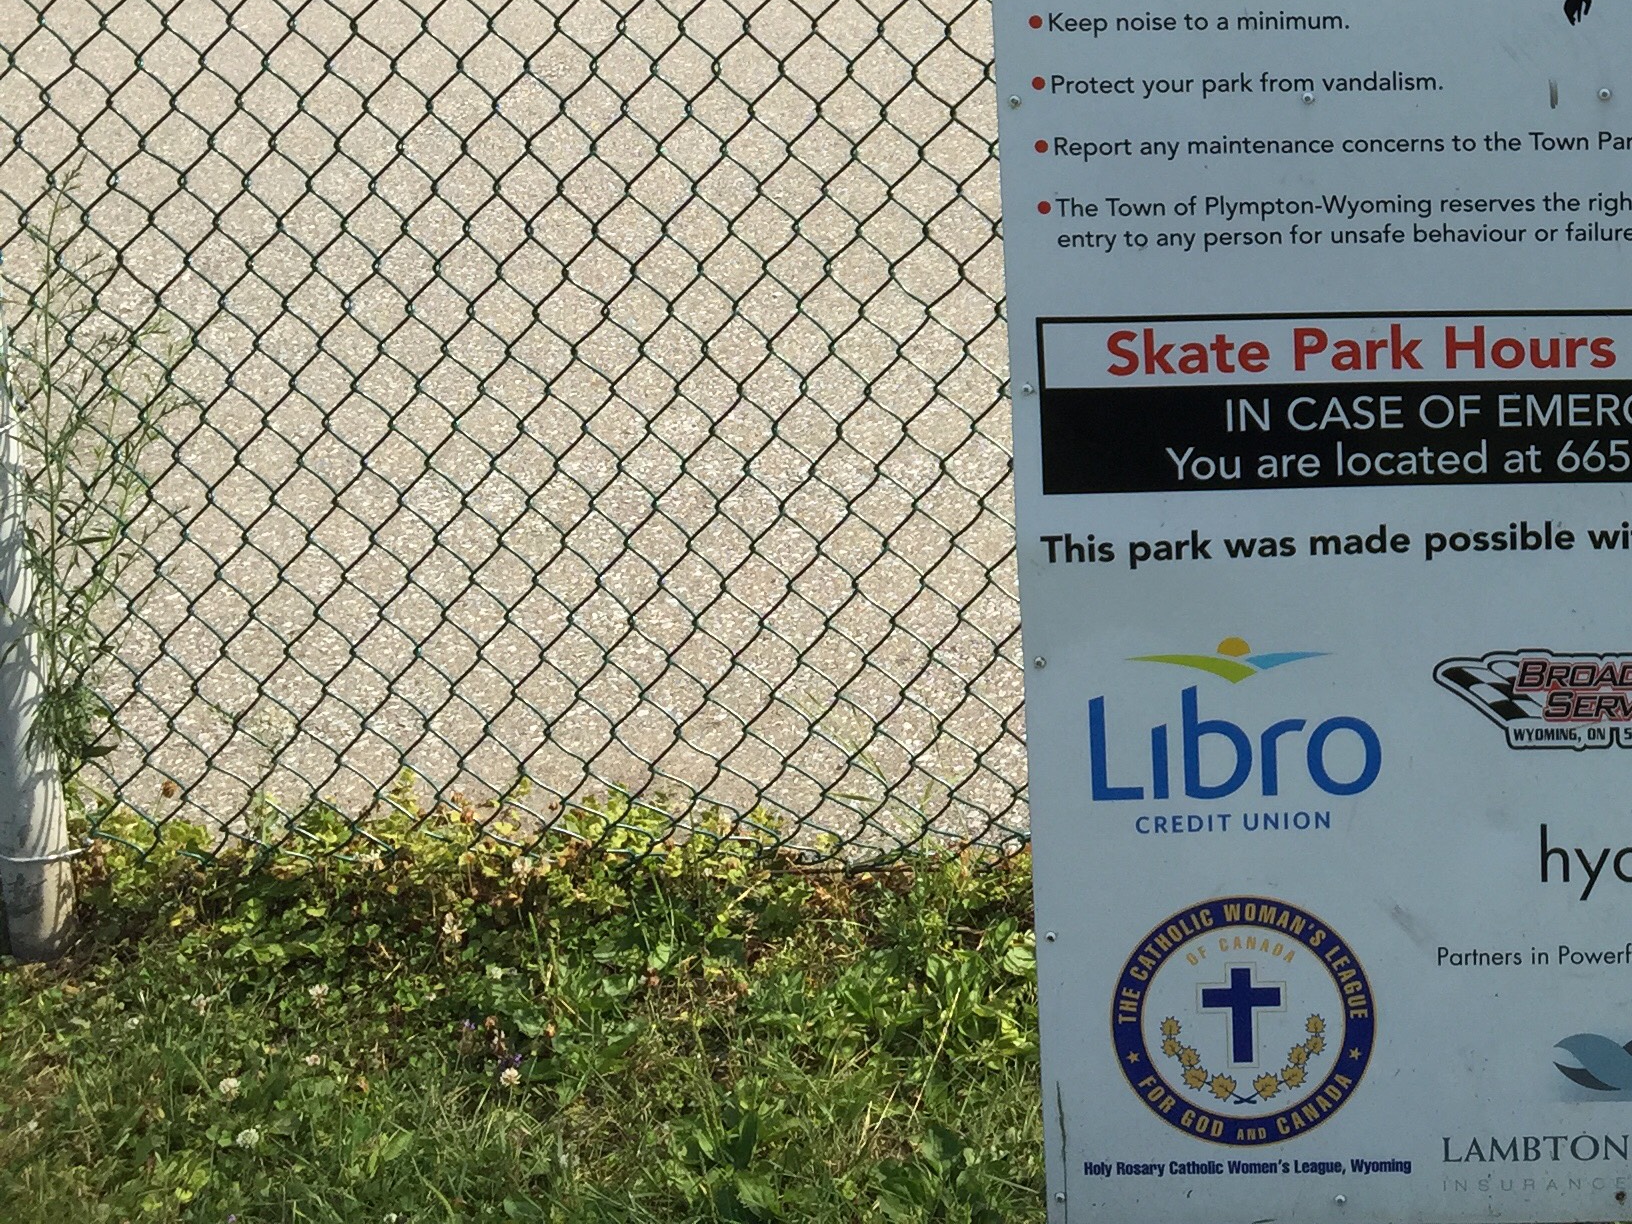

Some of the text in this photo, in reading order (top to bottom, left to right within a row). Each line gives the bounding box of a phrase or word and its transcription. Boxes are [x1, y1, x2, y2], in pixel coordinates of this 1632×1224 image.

[1048, 11, 1349, 38] Keep noise to a minimum.
[1051, 71, 1443, 99] Protect your park from vandalism.
[1053, 137, 1132, 162] Report
[1140, 142, 1179, 160] any
[1188, 135, 1334, 154] maintenance
[1342, 139, 1444, 153] concerns
[1452, 135, 1476, 151] to
[1484, 131, 1521, 151] the
[1528, 132, 1588, 150] Town
[1107, 328, 1269, 376] Skate
[1294, 324, 1423, 371] Park
[1446, 326, 1616, 369] Hours
[1227, 399, 1270, 431] IN
[1288, 396, 1403, 431] CASE
[1420, 395, 1480, 428] OF
[1166, 447, 1240, 480] You
[1258, 454, 1320, 478] are
[1337, 439, 1487, 476] located
[1504, 445, 1542, 473] at
[1557, 440, 1630, 472] 665
[1040, 534, 1115, 563] This
[1129, 530, 1212, 569] park
[1224, 537, 1296, 558] was
[1310, 524, 1410, 555] made
[1425, 521, 1575, 561] possible
[1088, 686, 1382, 801] Libro
[1514, 727, 1606, 743] WYOMING, ON
[1136, 811, 1330, 834] CREDIT UNION
[1118, 986, 1141, 1024] THE
[1130, 908, 1214, 980] CATHOLIC
[1324, 946, 1368, 1019] LEAGUE
[1186, 936, 1296, 966] OF CANADA
[1438, 947, 1522, 966] Partners
[1532, 947, 1548, 964] in
[1139, 1073, 1352, 1141] FOR GOD AND CANADA
[1442, 1135, 1630, 1163] LAMBTON
[1084, 1162, 1112, 1177] Holy
[1117, 1162, 1165, 1177] Rosary
[1169, 1161, 1223, 1175] Catholic
[1294, 1160, 1346, 1175] League,
[1351, 1159, 1411, 1175] Wyoming
